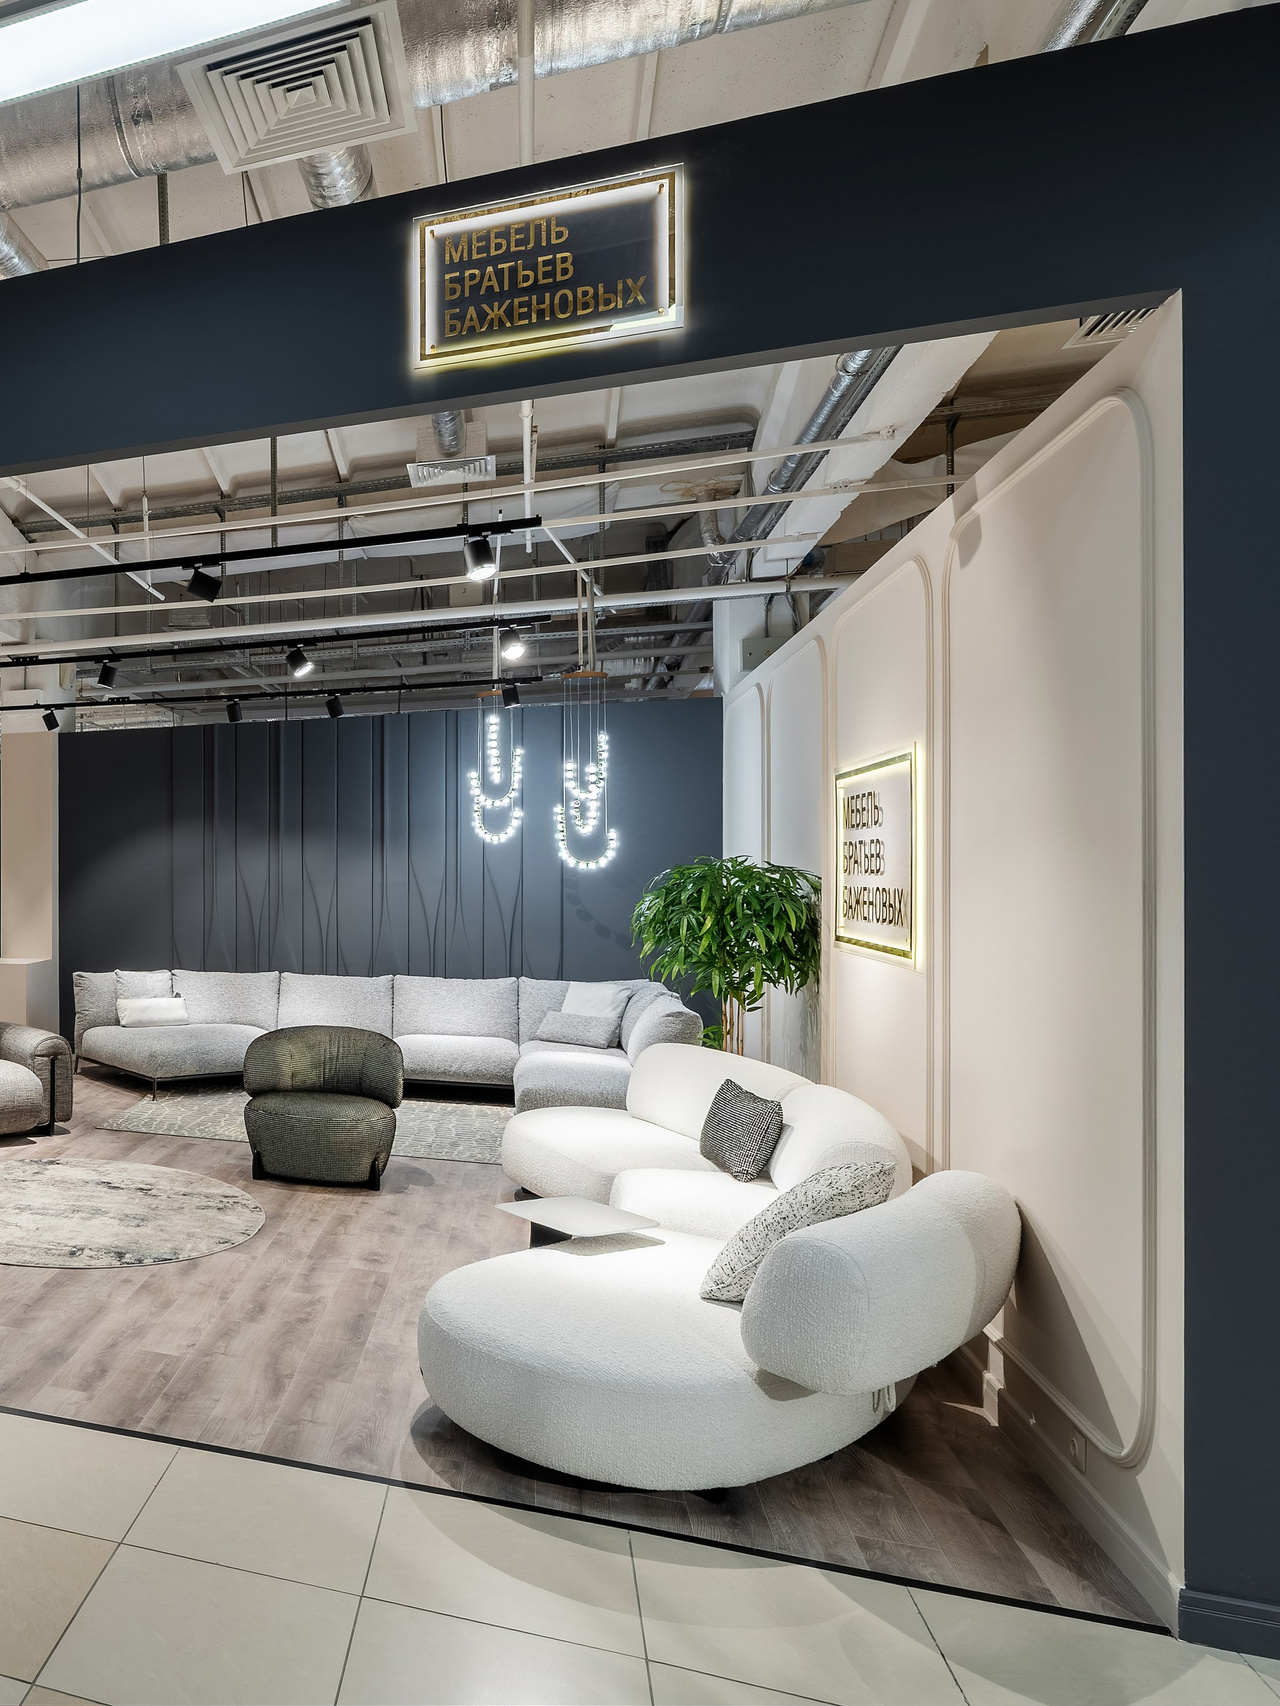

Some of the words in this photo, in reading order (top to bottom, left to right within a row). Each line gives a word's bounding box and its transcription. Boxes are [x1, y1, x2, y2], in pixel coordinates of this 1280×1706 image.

[444, 216, 569, 265] МЕБЕЛЬ
[444, 251, 575, 301] БРАТЬЕВ
[444, 275, 647, 338] БАЖЕНОВЫХ
[843, 791, 880, 829] МЕБЕЛЬ
[843, 838, 881, 875] БРАТЬЕВ
[843, 886, 904, 927] БАЖЕНОВЫХ
